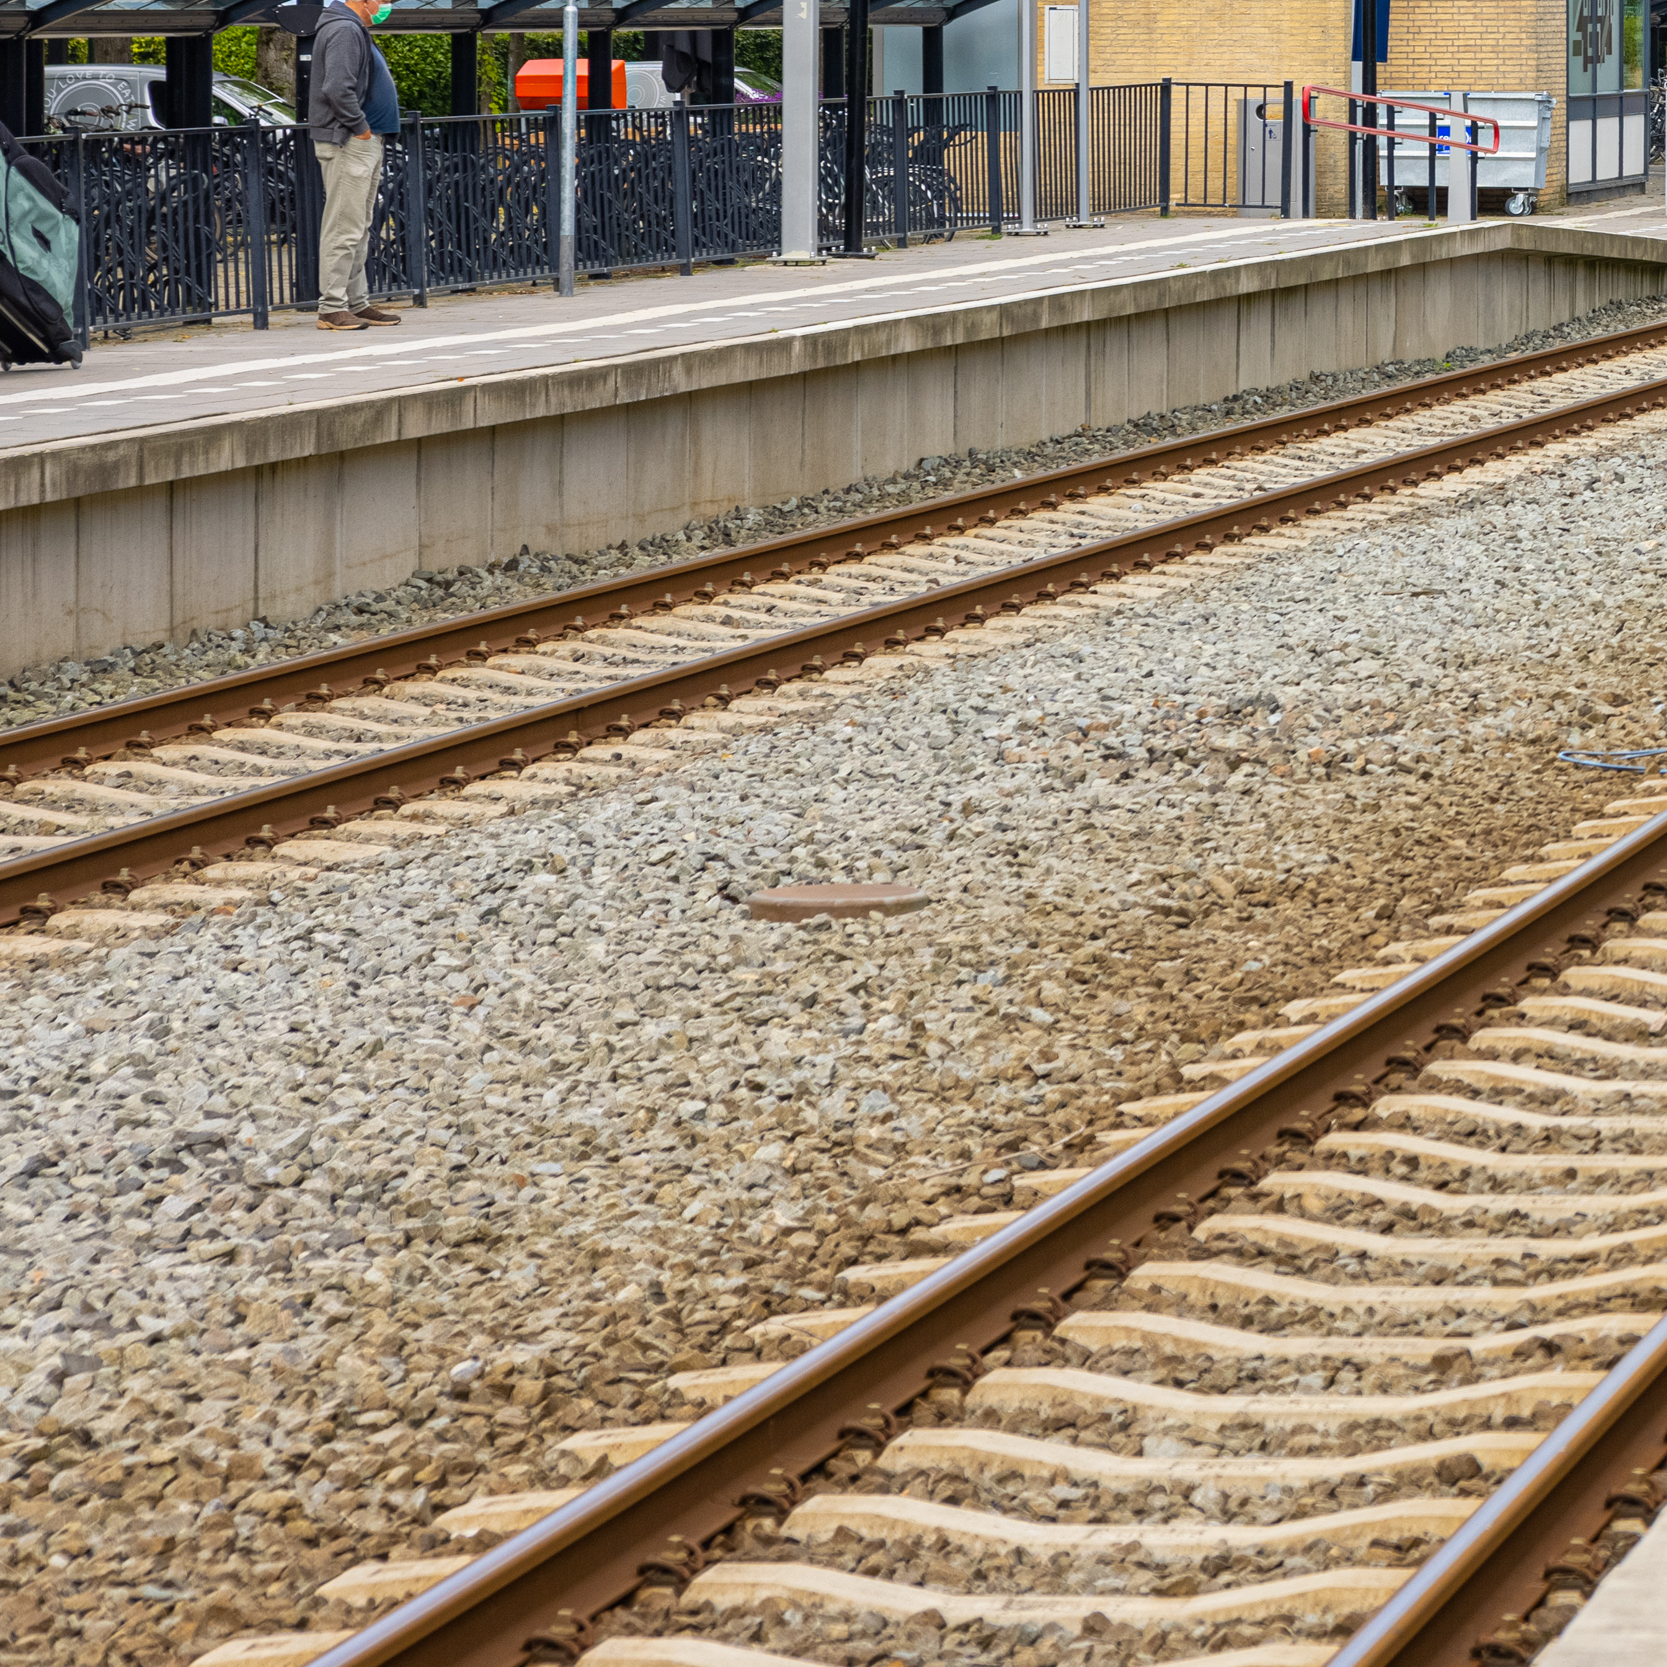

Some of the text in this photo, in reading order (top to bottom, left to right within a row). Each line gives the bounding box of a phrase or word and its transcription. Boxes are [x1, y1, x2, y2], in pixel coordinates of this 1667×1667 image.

[58, 71, 93, 89] LOVE
[99, 70, 115, 83] TO
[117, 82, 136, 103] EAT
